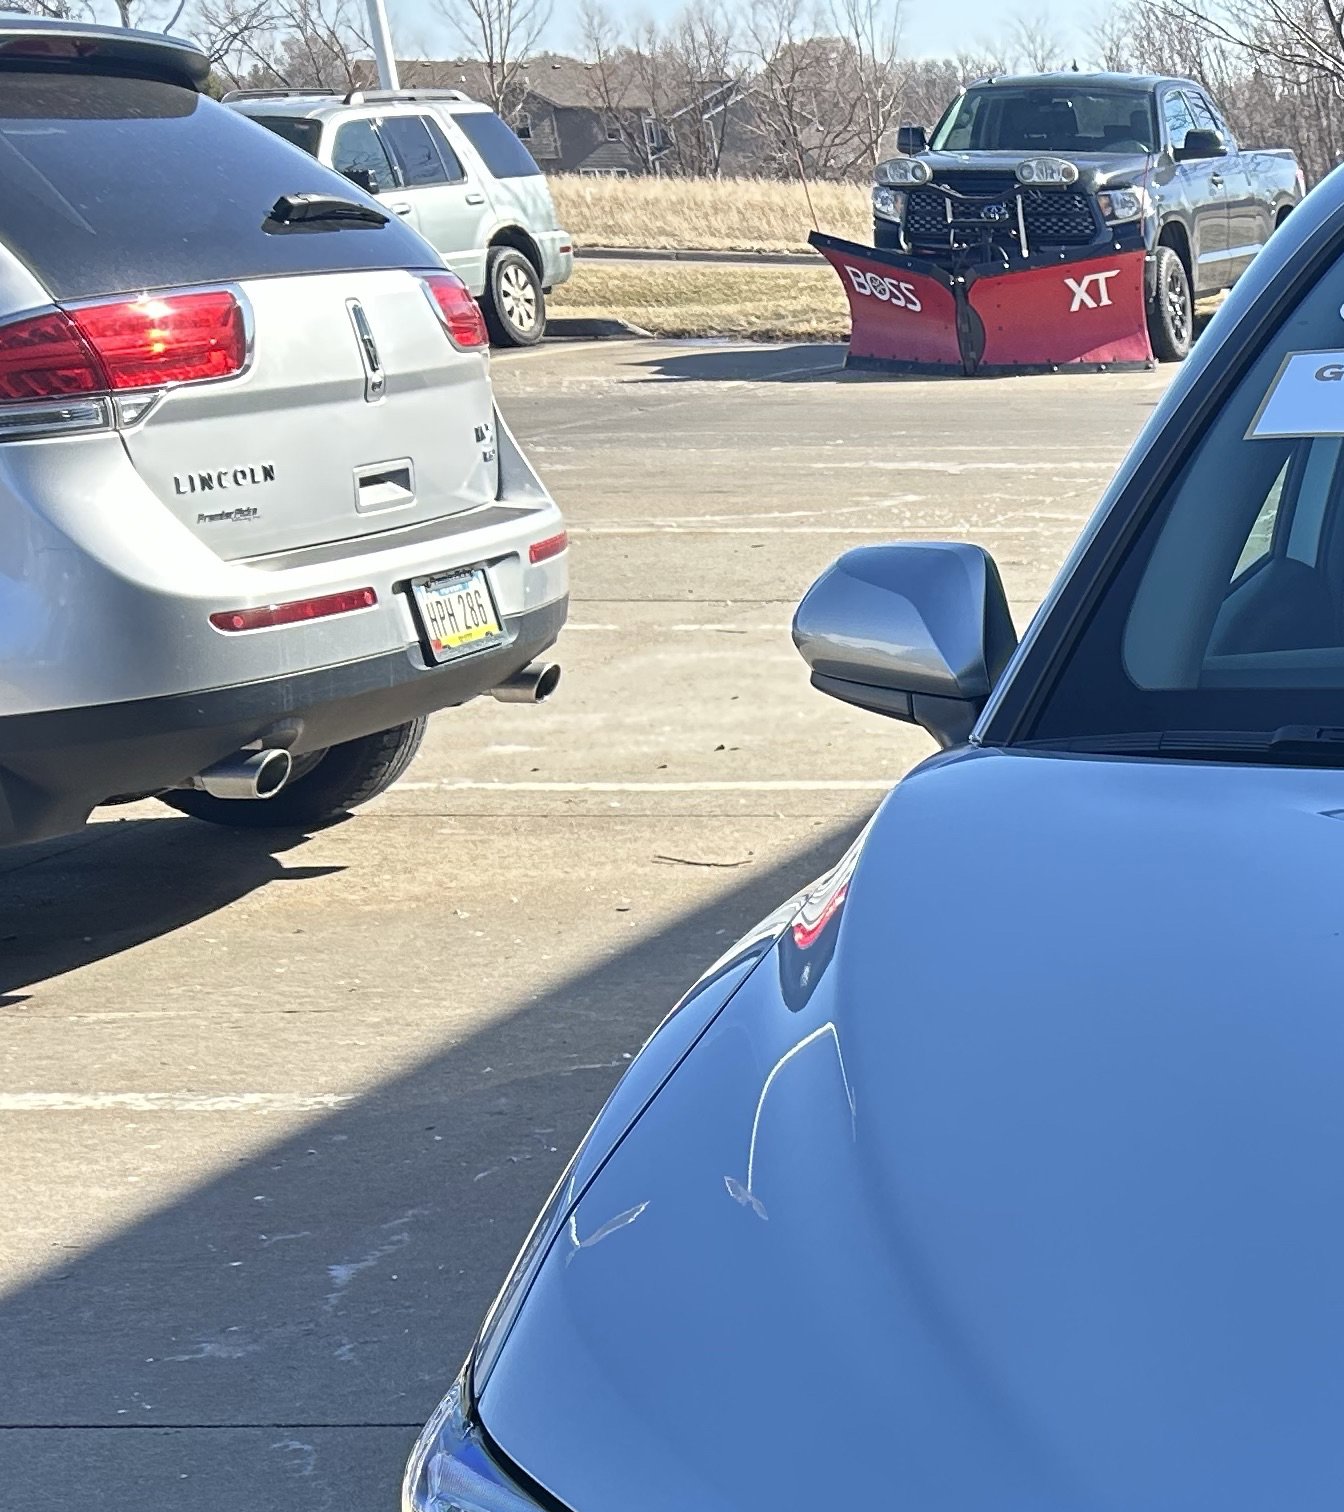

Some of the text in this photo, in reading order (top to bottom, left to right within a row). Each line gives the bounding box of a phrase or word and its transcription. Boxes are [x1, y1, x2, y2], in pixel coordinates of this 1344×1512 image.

[843, 264, 922, 313] BOSS
[1063, 269, 1121, 313] XT
[173, 463, 276, 495] LINCOLN
[457, 589, 488, 630] 286
